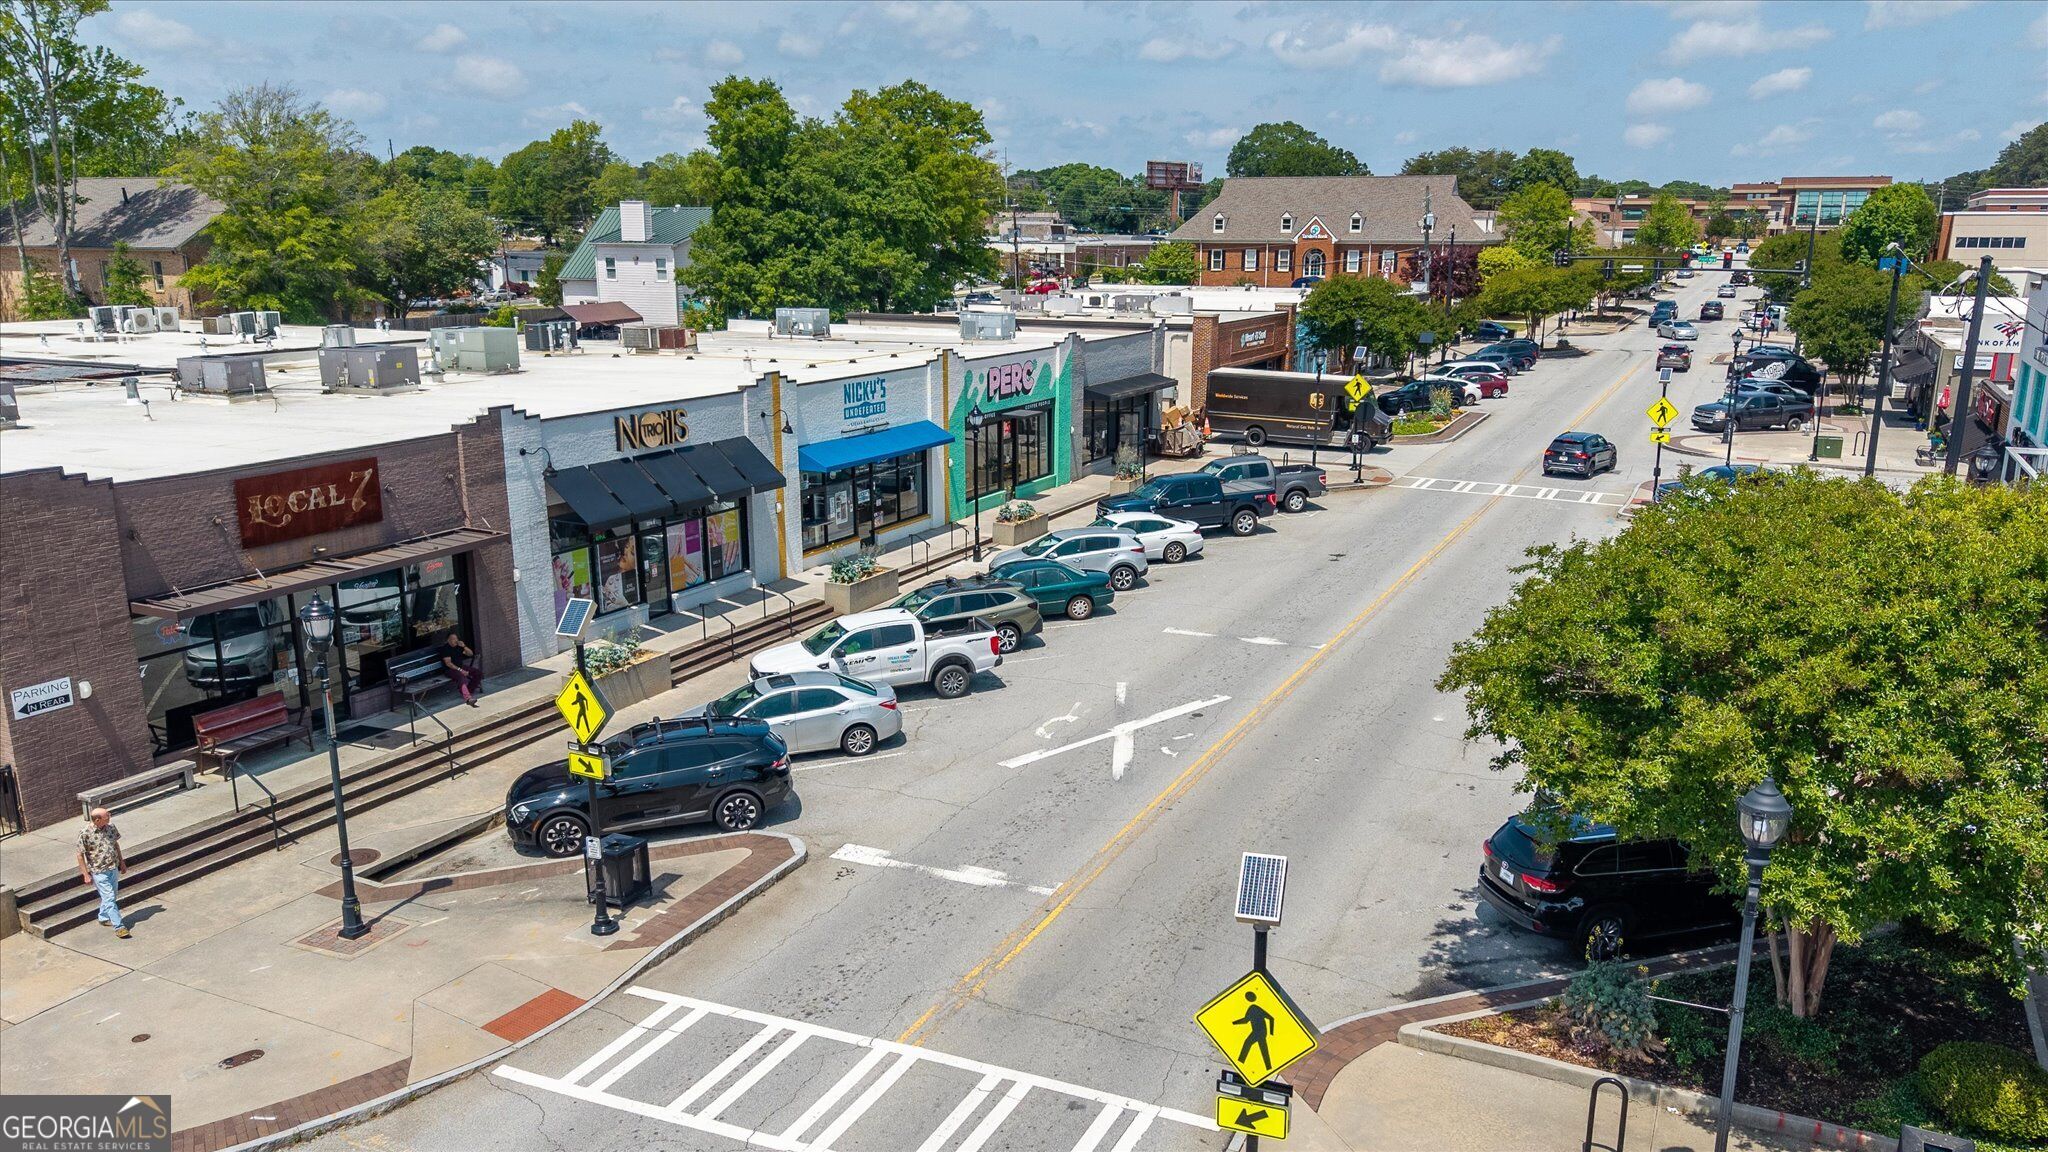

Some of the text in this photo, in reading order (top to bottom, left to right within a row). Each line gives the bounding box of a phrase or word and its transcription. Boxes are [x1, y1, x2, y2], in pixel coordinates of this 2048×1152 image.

[844, 377, 886, 404] NICKY'S
[987, 360, 1035, 402] PERC
[845, 403, 884, 418] UNDEFEATED
[642, 422, 664, 438] TRIO
[247, 468, 373, 527] LOCAL 7
[13, 680, 70, 703] PARKING
[27, 697, 65, 712] IN REAR
